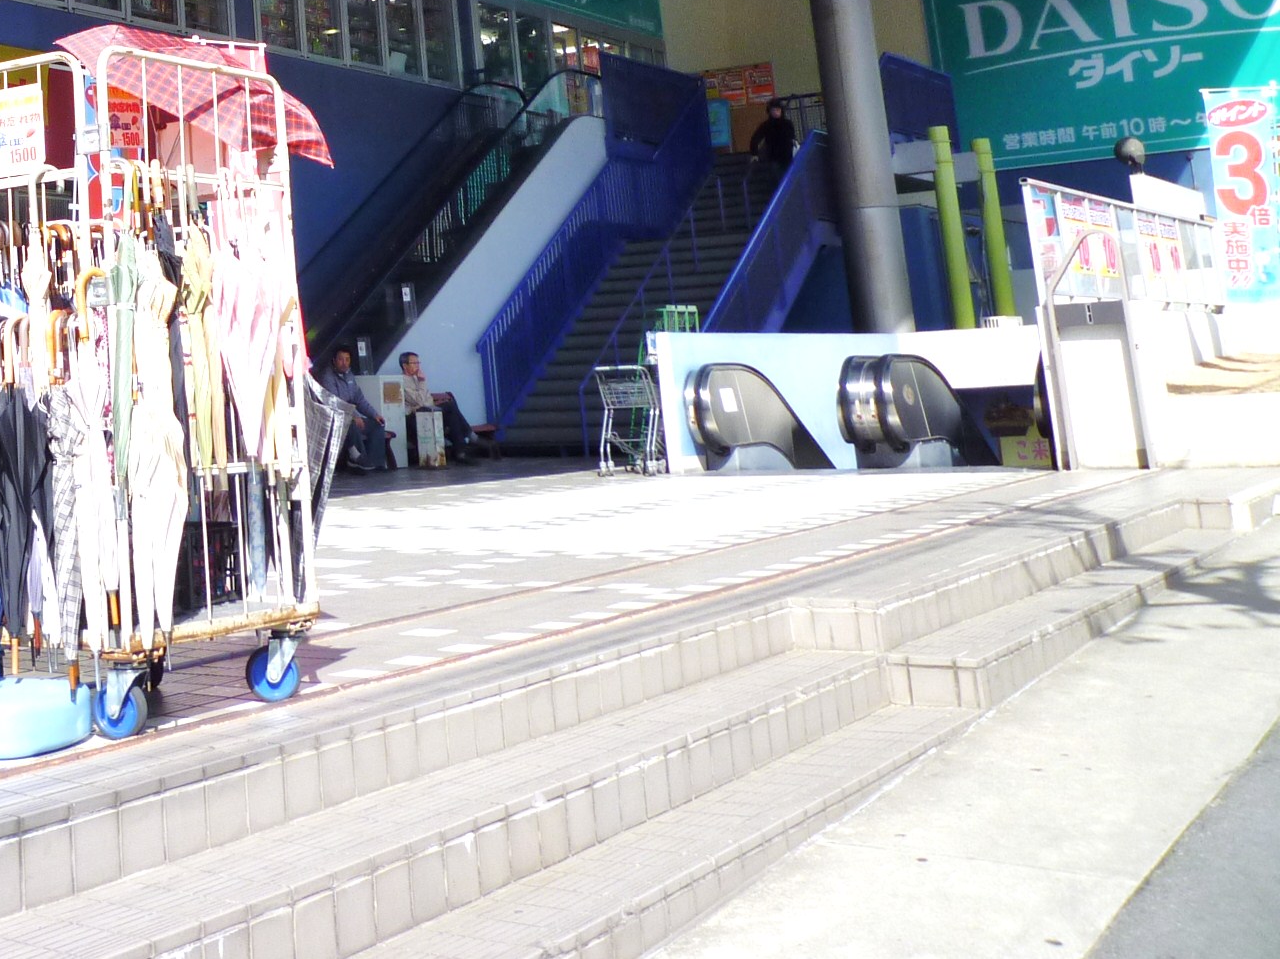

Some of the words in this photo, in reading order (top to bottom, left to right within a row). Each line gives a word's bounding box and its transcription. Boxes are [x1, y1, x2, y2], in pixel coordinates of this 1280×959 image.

[1069, 44, 1203, 90] ダイソー
[1210, 102, 1267, 125] ポイント
[1002, 127, 1076, 150] 営業時間
[10, 147, 37, 164] 1500
